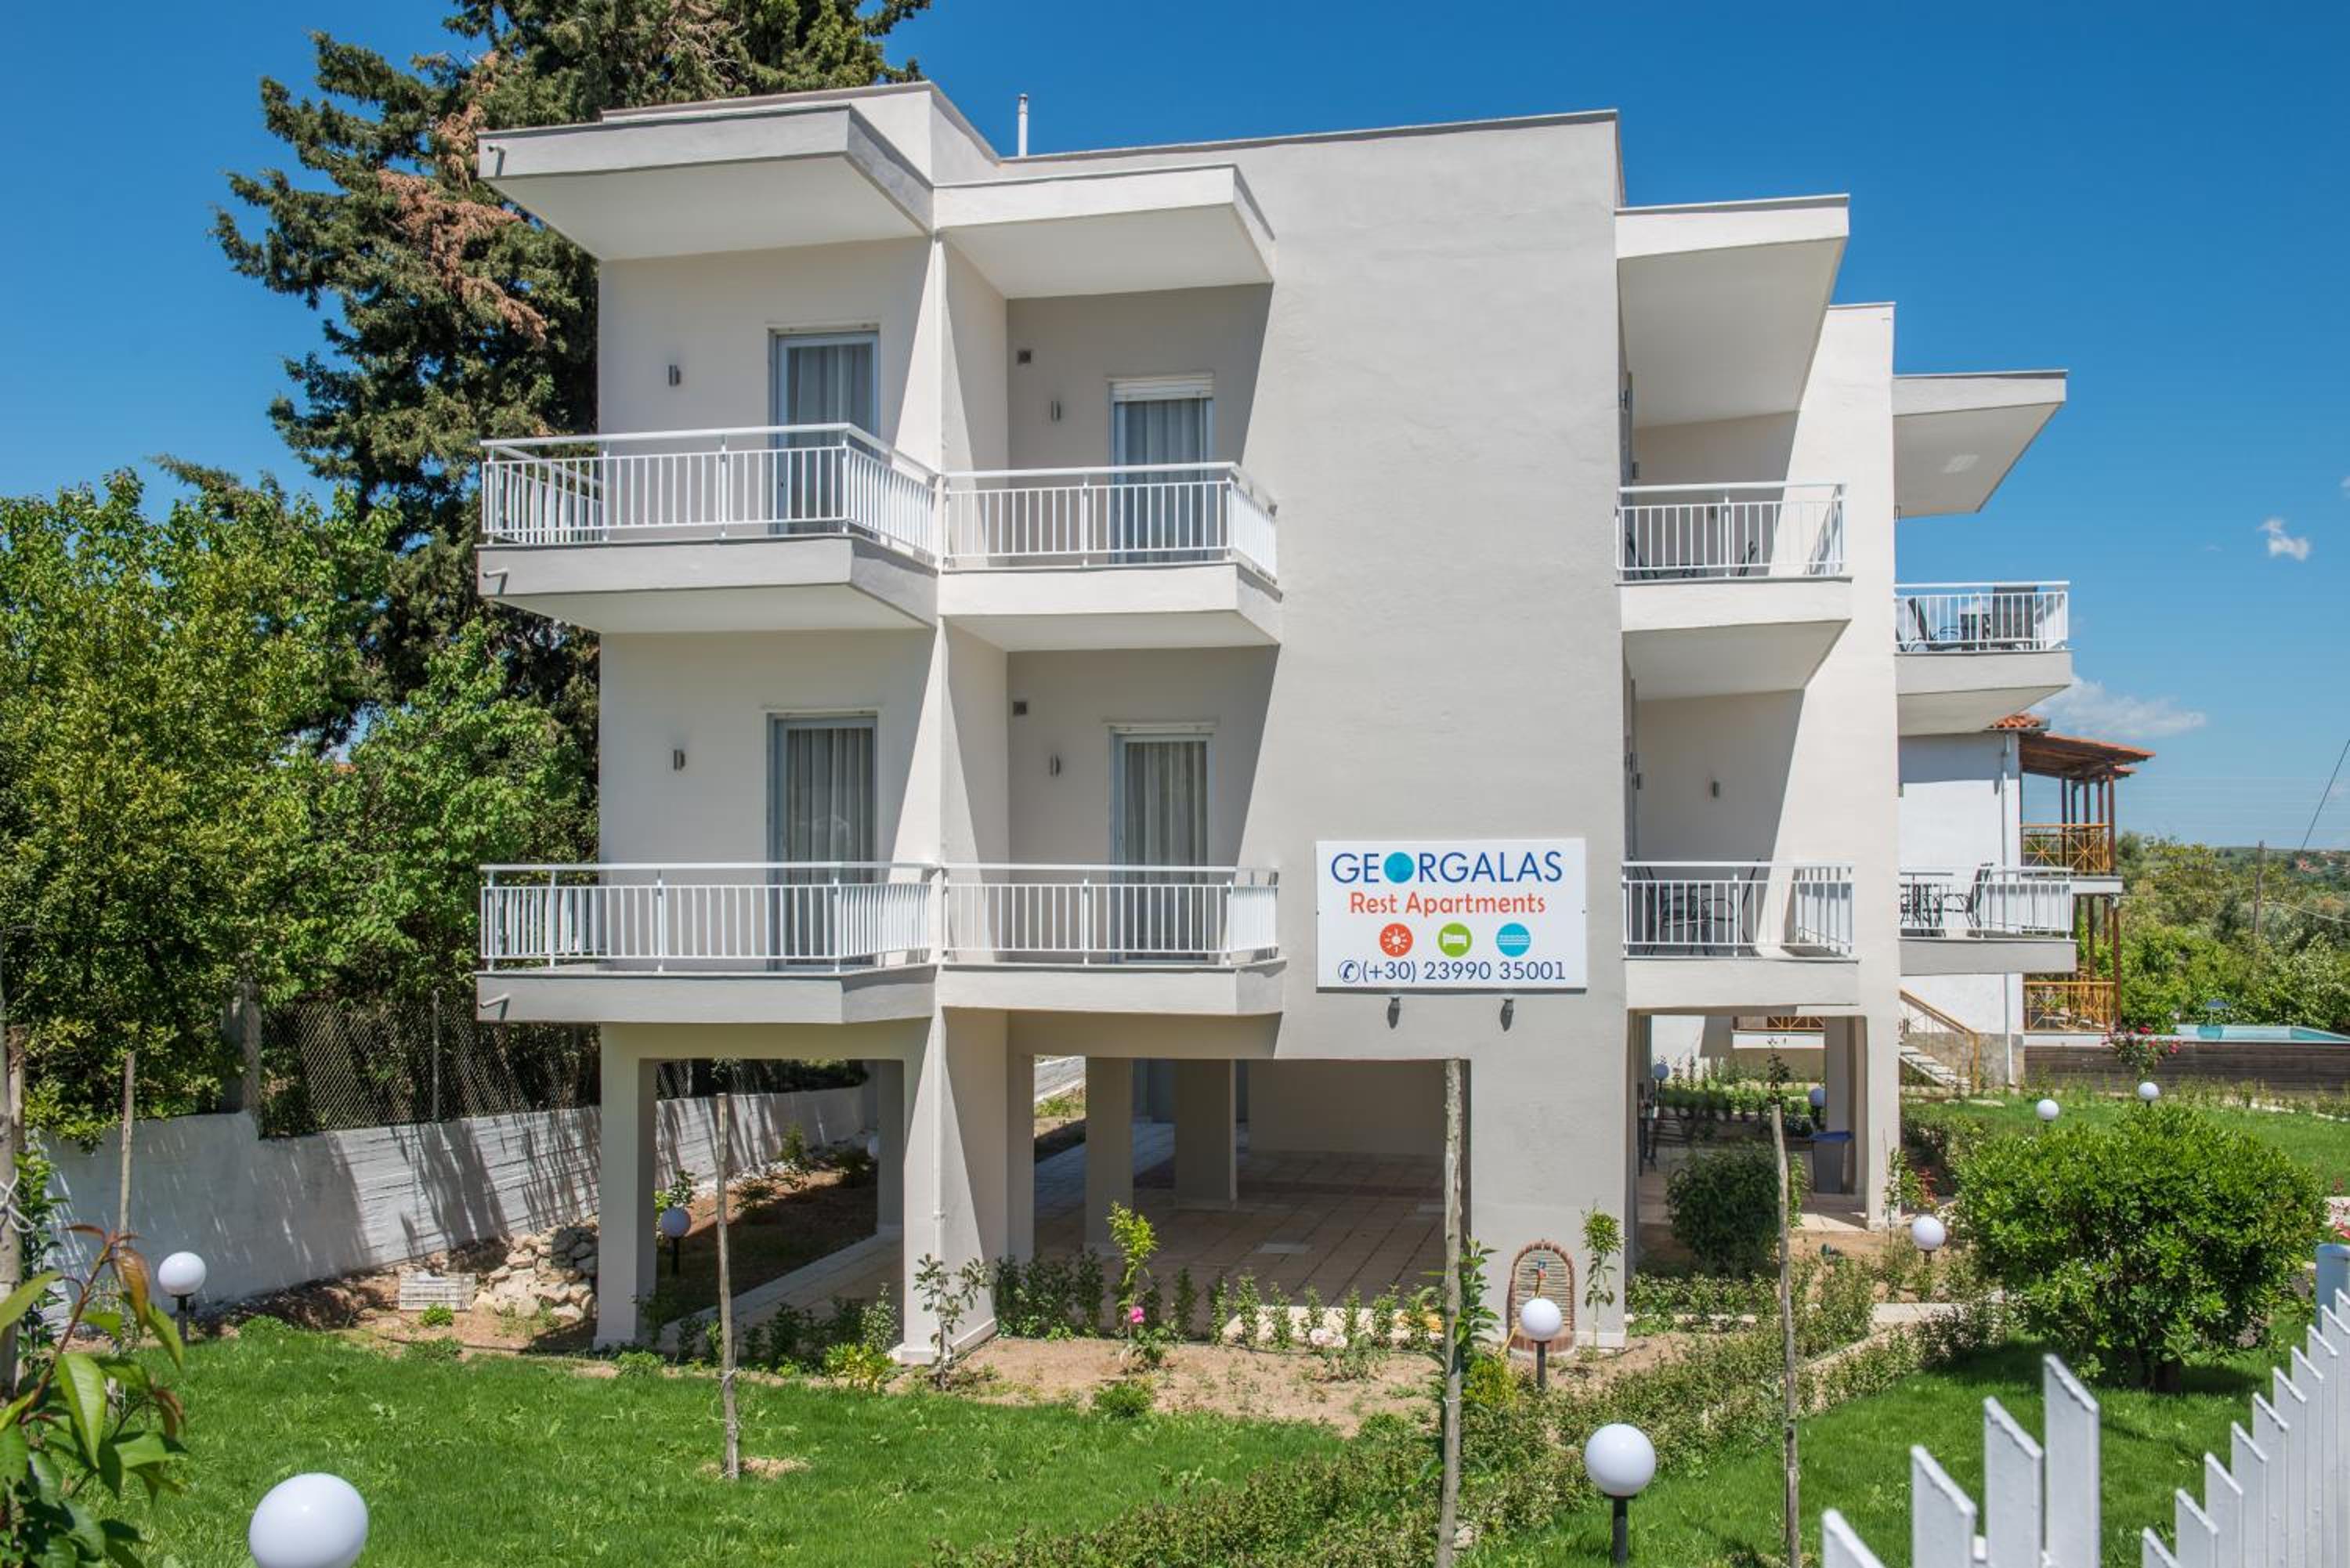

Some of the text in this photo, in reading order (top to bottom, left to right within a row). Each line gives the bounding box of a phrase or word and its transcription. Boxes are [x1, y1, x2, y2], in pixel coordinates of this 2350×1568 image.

[1331, 851, 1564, 883] GEORGALAS
[1350, 891, 1546, 917] Rest Apartments
[1362, 960, 1566, 983] (+30) 23990 35001
